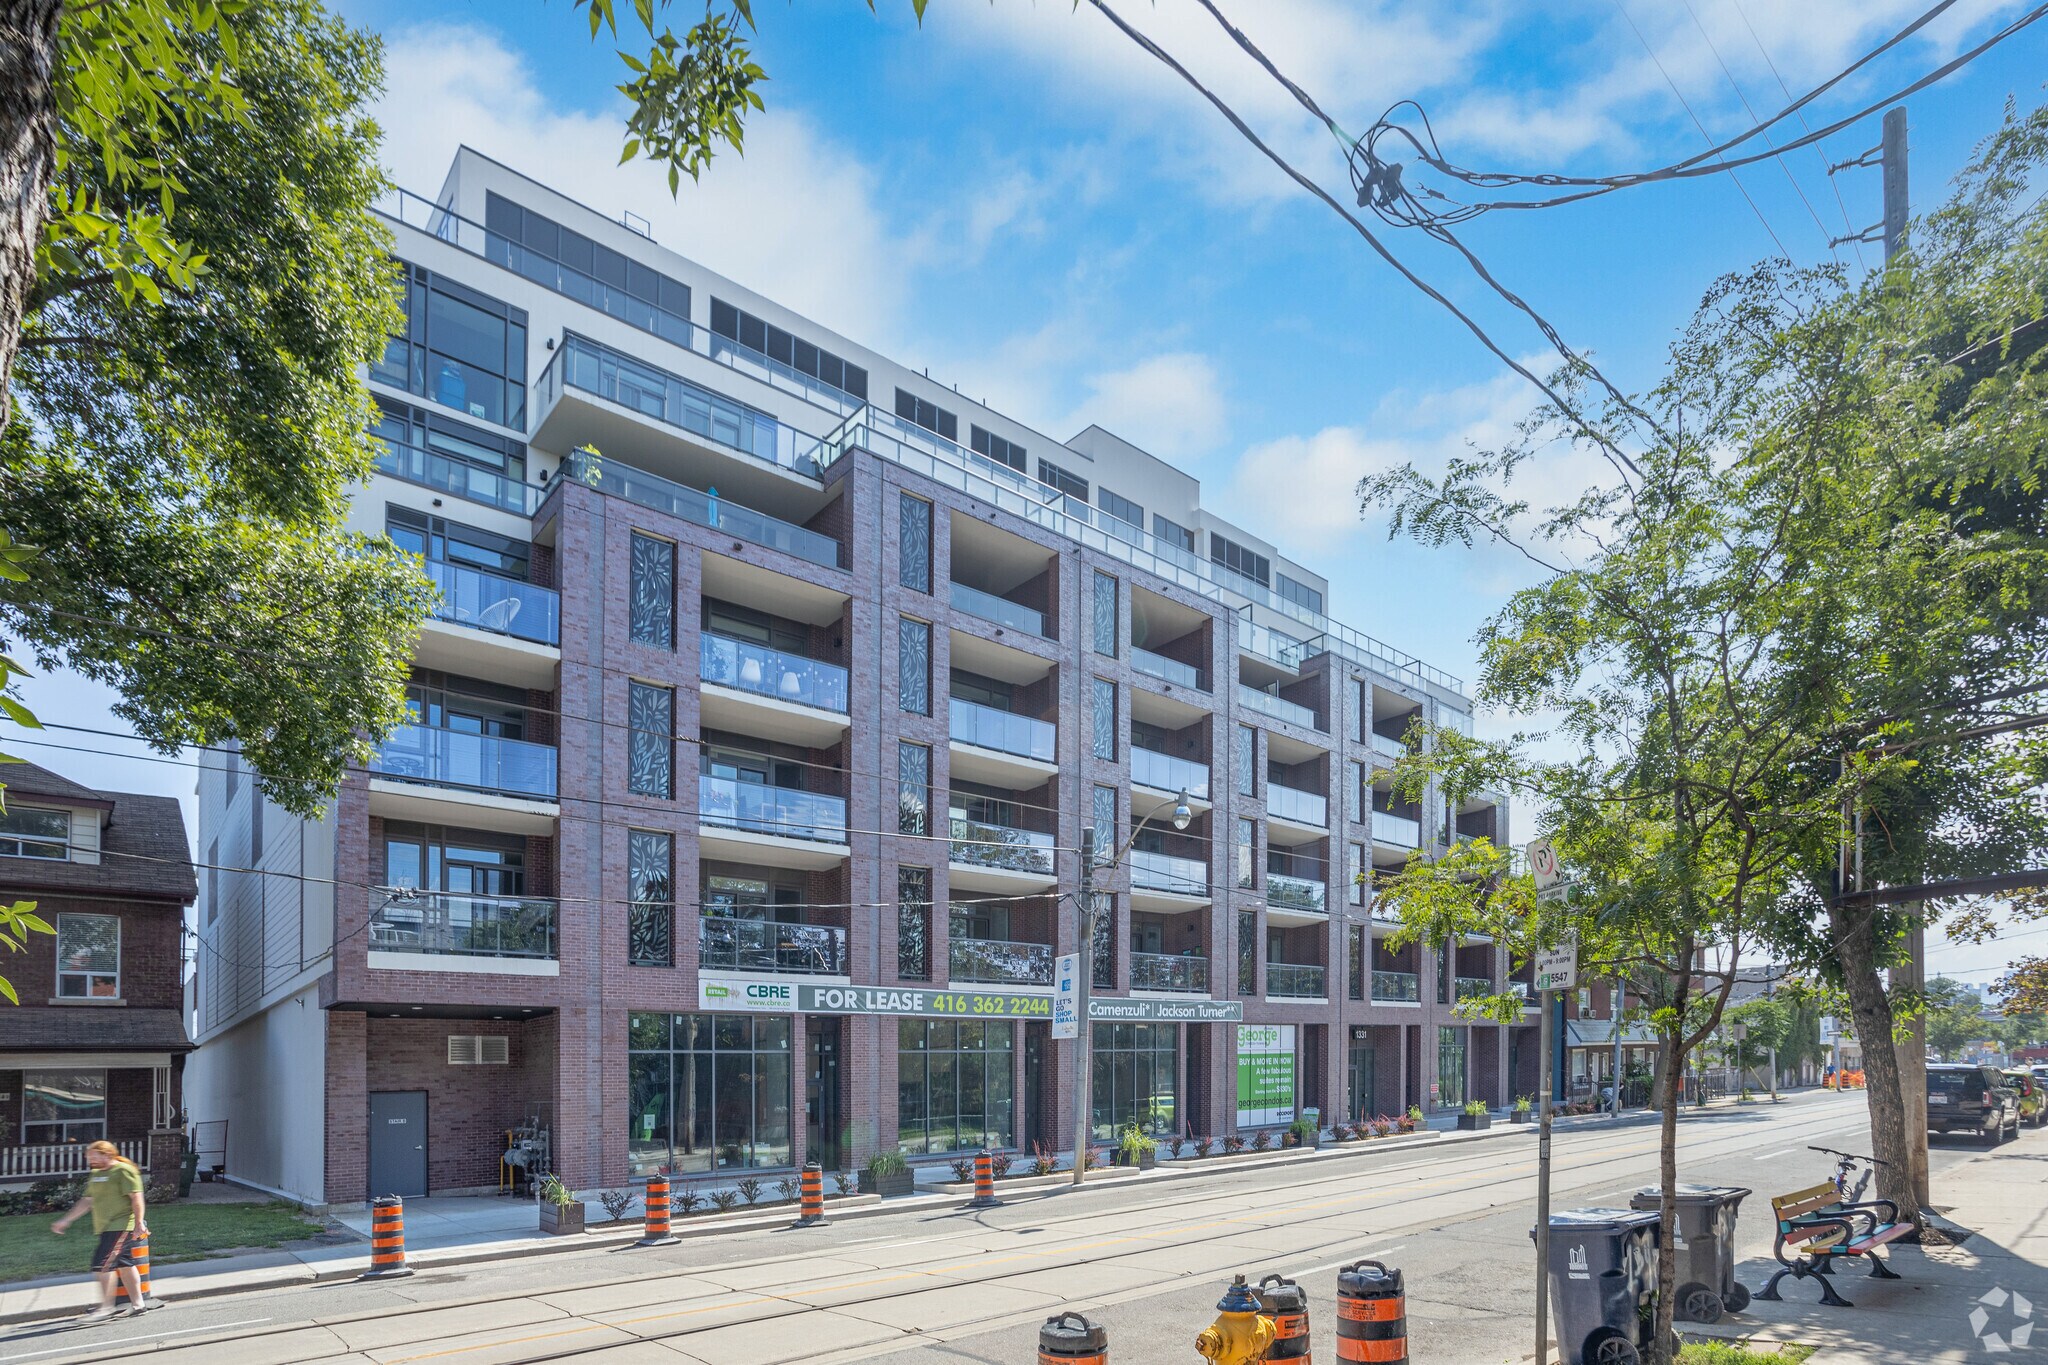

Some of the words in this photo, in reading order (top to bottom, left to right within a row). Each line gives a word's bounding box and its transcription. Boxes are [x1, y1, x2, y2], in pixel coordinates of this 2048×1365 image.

[1551, 972, 1568, 983] 5547
[746, 985, 790, 999] CBRE
[814, 989, 858, 1009] FOR
[866, 991, 923, 1011] LEASE
[933, 994, 967, 1013] 416
[973, 996, 1004, 1014] 362
[1010, 997, 1049, 1015] 2244
[1056, 998, 1072, 1006] LET'S
[1157, 1003, 1195, 1018] Jackson
[1055, 1016, 1078, 1024] SMALL
[1237, 1026, 1278, 1047] George
[1239, 1058, 1250, 1066] BUY
[1273, 1057, 1279, 1065] IN
[1238, 1097, 1292, 1109] georgecondos.ca
